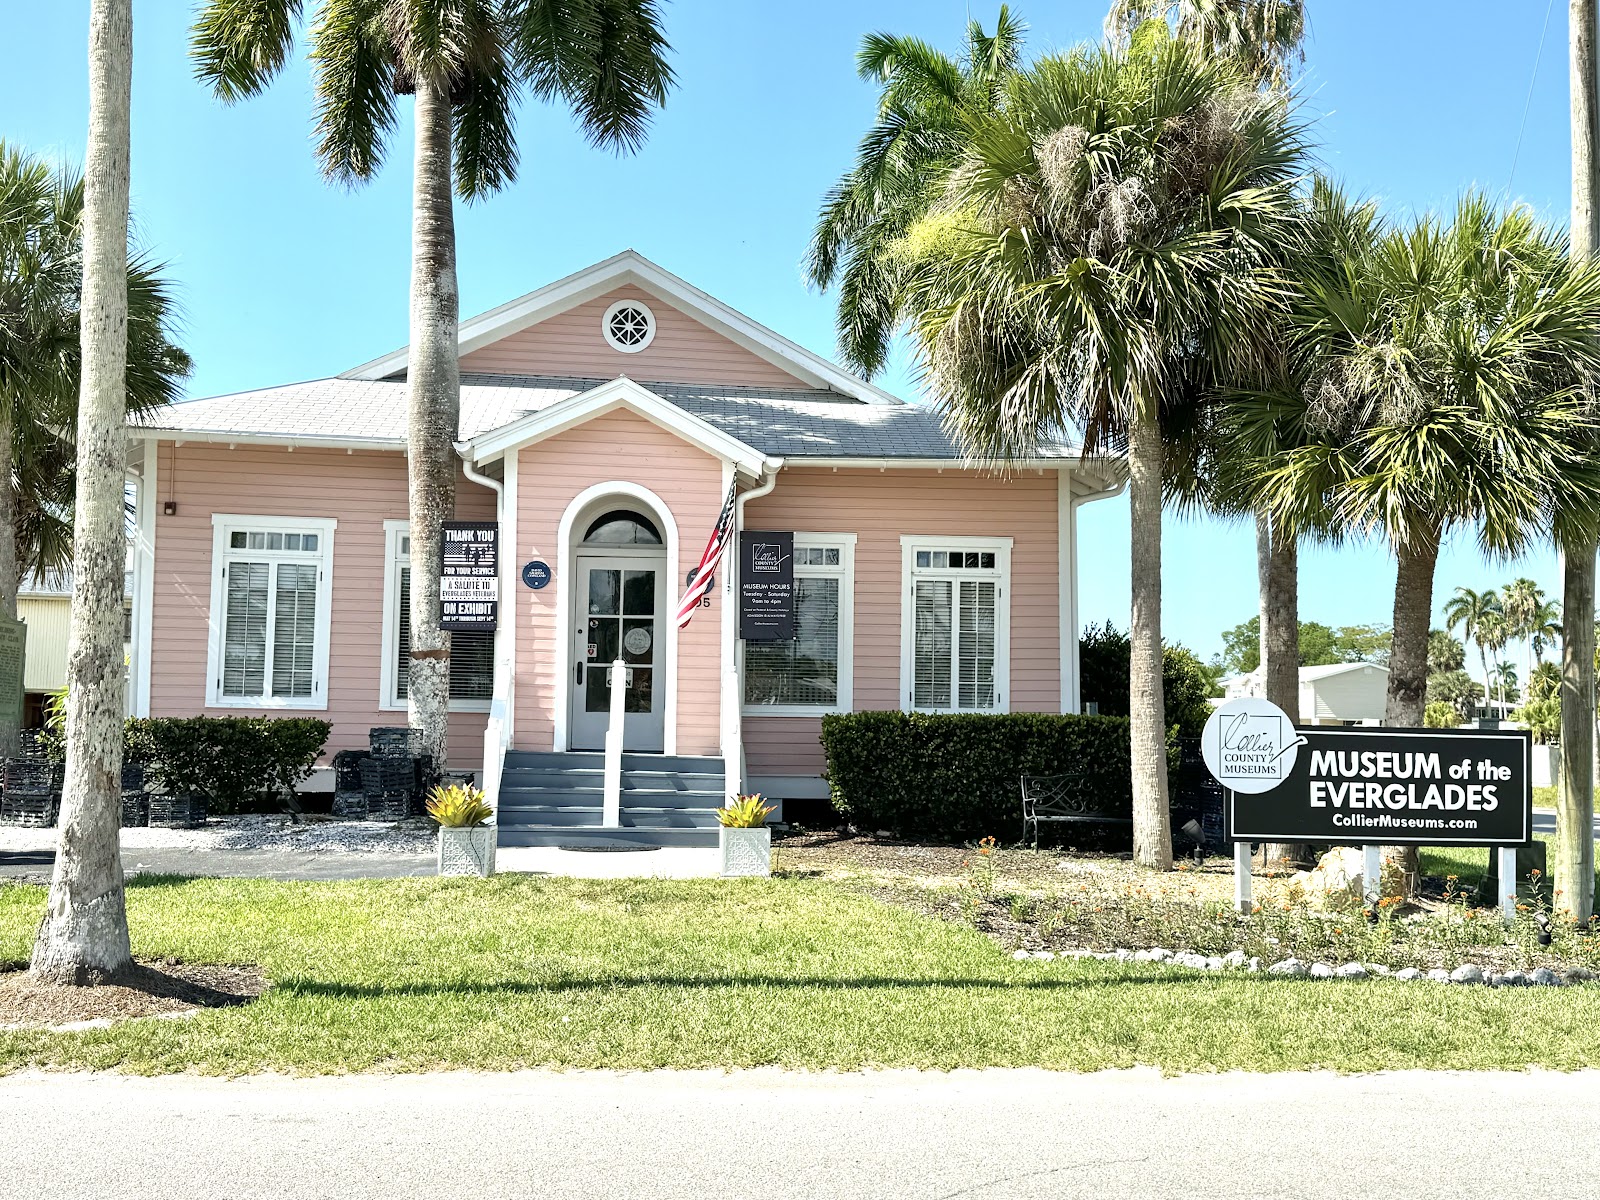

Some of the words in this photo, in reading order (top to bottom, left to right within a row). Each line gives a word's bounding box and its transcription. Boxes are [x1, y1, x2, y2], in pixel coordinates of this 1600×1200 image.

[445, 530, 474, 542] THANK
[477, 530, 494, 542] YOU
[444, 567, 455, 575] FOR
[456, 567, 471, 575] YOUR
[472, 567, 495, 575] SERVICE
[448, 581, 452, 589] A
[454, 581, 480, 589] SALUTE
[482, 581, 490, 589] TO
[443, 602, 456, 614] ON
[458, 602, 492, 615] EXHIBIT
[1221, 712, 1274, 764] Collier
[1224, 753, 1267, 762] COUNTY
[1224, 765, 1277, 774] MUSEUMS
[1309, 750, 1441, 779] MUSEUM
[1448, 758, 1472, 780] of
[1476, 759, 1512, 781] the
[1309, 781, 1499, 811] EVERGLADES
[1332, 813, 1478, 829] CollierMuseums.com
